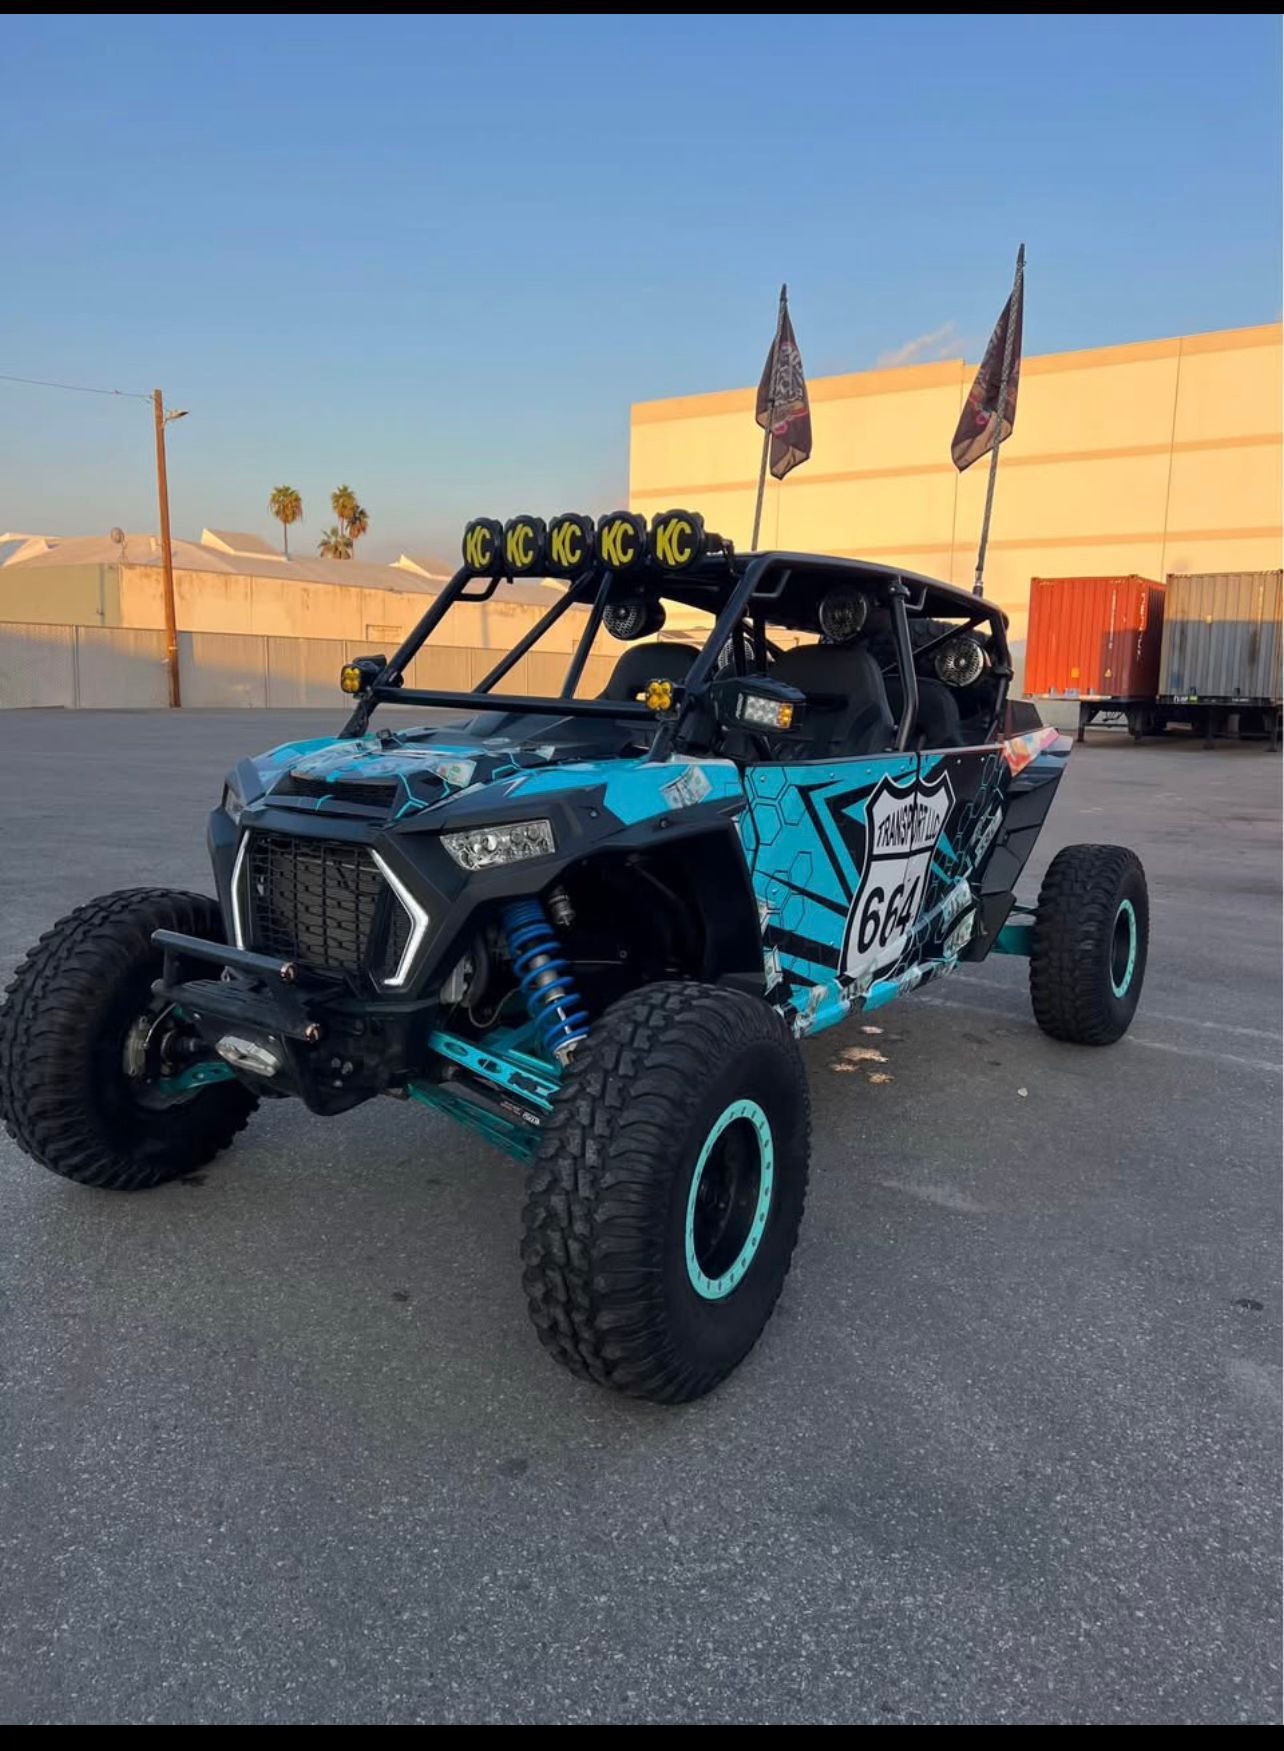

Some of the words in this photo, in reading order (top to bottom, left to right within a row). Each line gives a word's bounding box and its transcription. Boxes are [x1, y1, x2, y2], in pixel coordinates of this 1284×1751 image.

[466, 525, 491, 568] KC
[506, 523, 534, 568] KC
[551, 521, 582, 567] KC
[601, 519, 635, 566] KC
[656, 518, 692, 566] KC
[877, 804, 928, 847] TRANSPORT
[858, 876, 921, 953] 664
